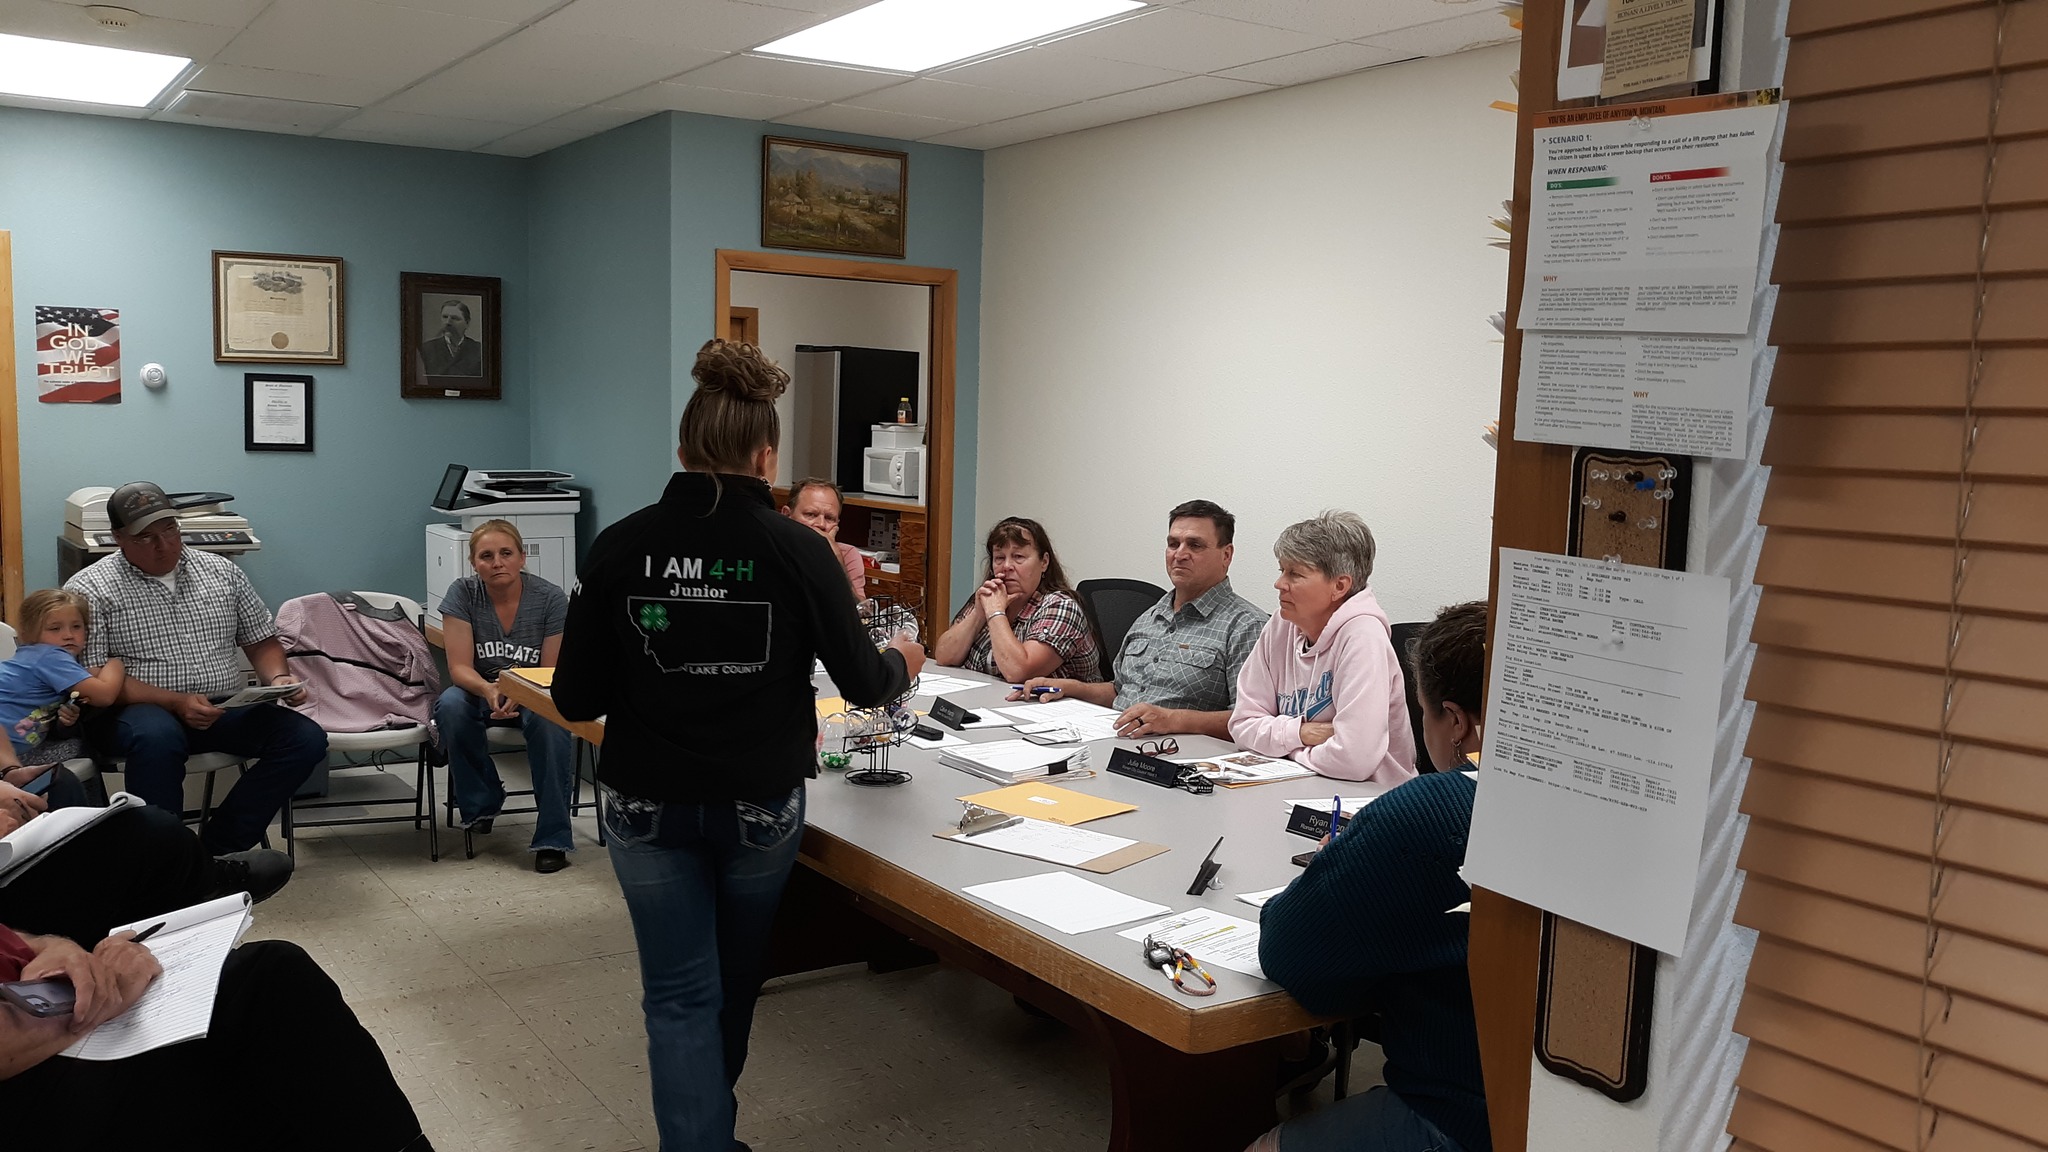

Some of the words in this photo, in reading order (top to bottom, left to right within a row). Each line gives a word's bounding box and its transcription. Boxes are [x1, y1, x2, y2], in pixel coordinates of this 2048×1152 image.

[1547, 114, 1565, 124] YOU'RE
[1567, 113, 1575, 122] AN
[1575, 110, 1602, 121] EMPLOYEE
[1602, 110, 1609, 118] OF
[1548, 134, 1583, 144] SCENARIO
[1567, 164, 1608, 173] RESPONDING:
[68, 322, 88, 337] IN
[50, 335, 98, 350] GOD
[62, 350, 96, 364] WE
[44, 362, 114, 378] TRUST
[644, 554, 651, 578] I
[662, 556, 702, 580] AM
[709, 558, 754, 582] 4-H
[670, 582, 728, 598] Junior
[476, 641, 540, 664] BOBCATS
[688, 665, 718, 675] LAKE
[722, 664, 766, 674] COUNTY
[1127, 758, 1139, 768] Julie
[1140, 762, 1156, 772] Moore
[1309, 814, 1328, 828] Ryan
[1300, 822, 1314, 832] Ronan
[1316, 827, 1324, 836] City
